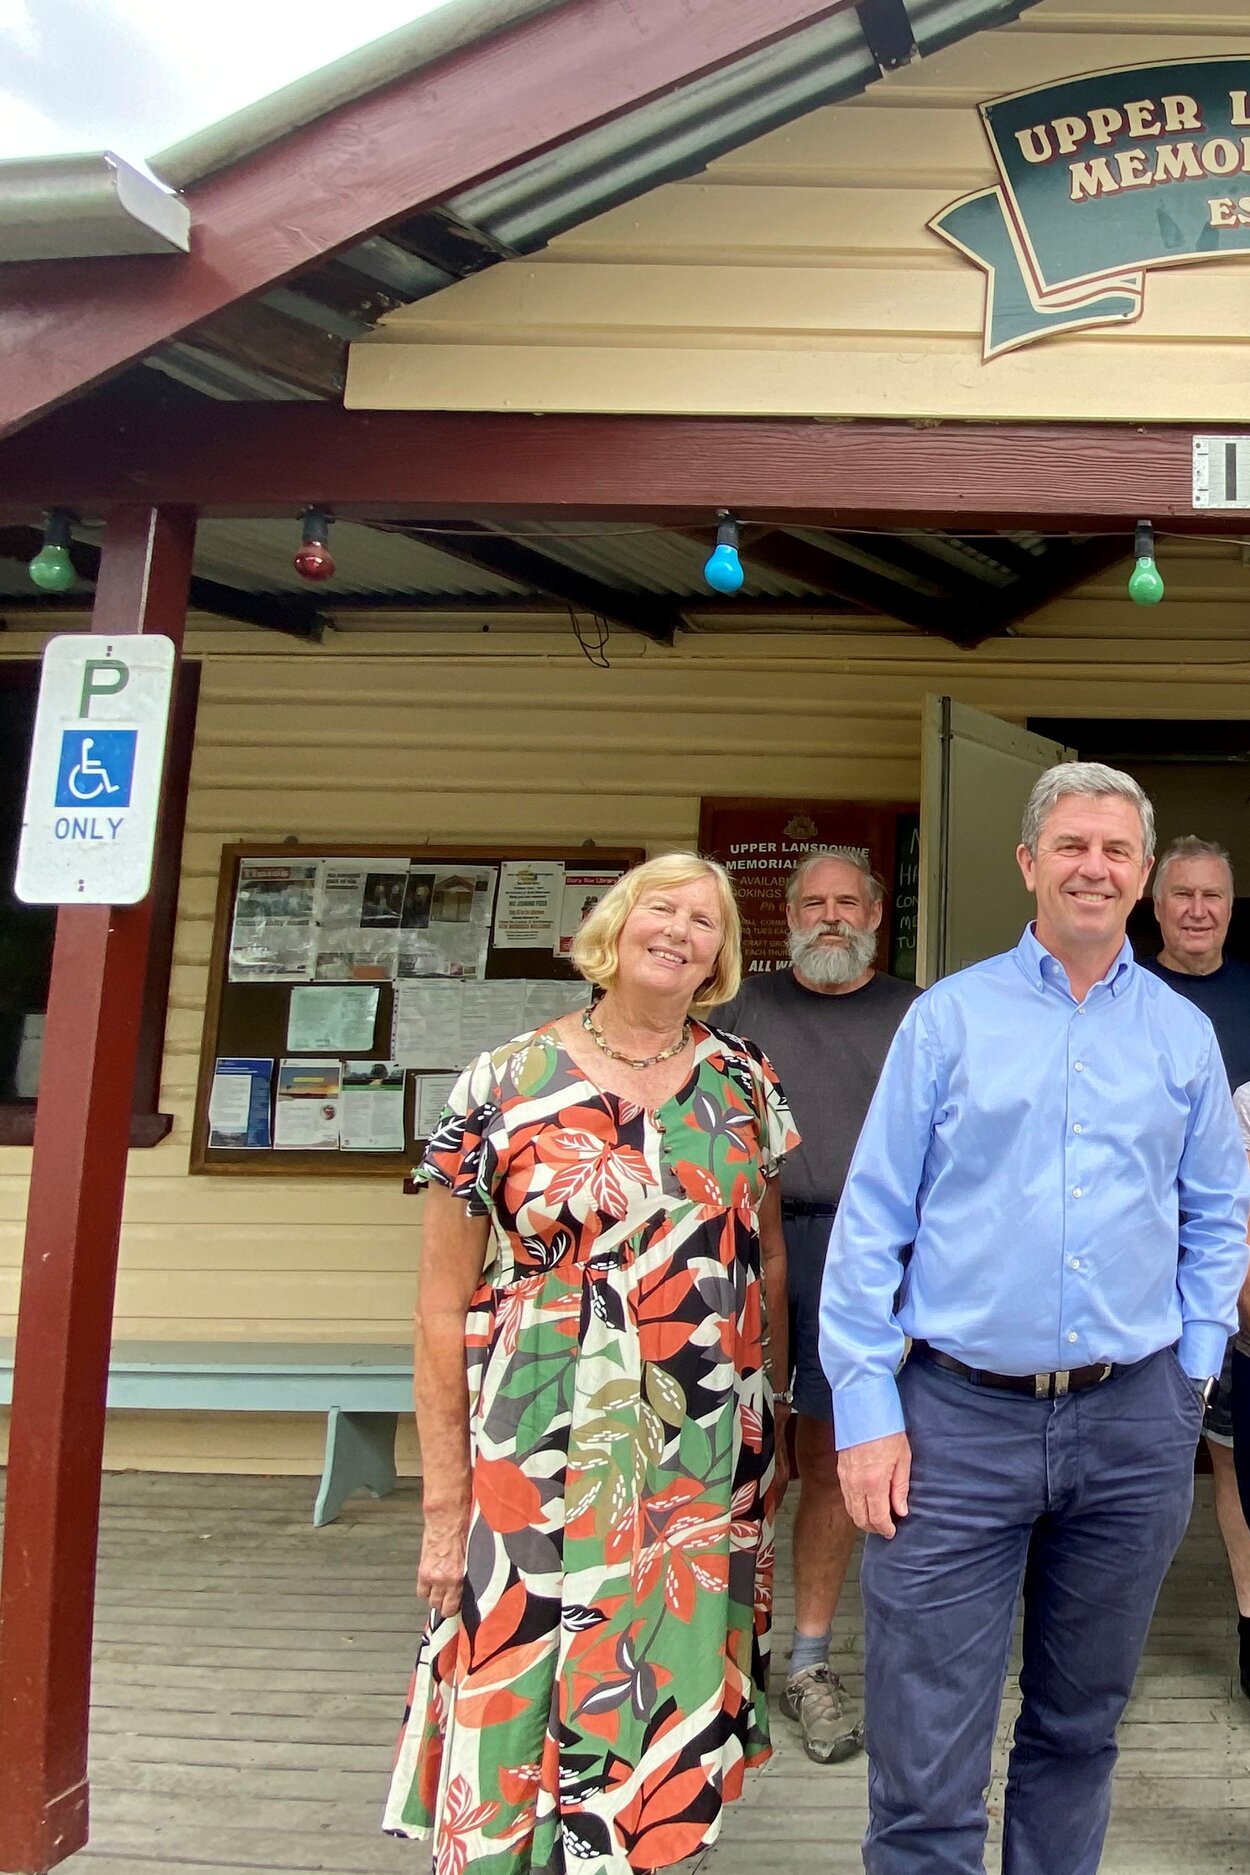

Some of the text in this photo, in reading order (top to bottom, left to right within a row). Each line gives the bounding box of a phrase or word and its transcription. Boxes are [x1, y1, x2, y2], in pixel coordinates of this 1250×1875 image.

[1014, 95, 1204, 165] UPPER
[79, 659, 130, 718] P
[55, 817, 124, 840] ONLY
[730, 842, 776, 854] UPPER
[725, 859, 798, 870] MEMORIAL
[740, 876, 788, 887] AVAILAB
[733, 888, 782, 898] OKINGS
[748, 960, 772, 972] ALL
